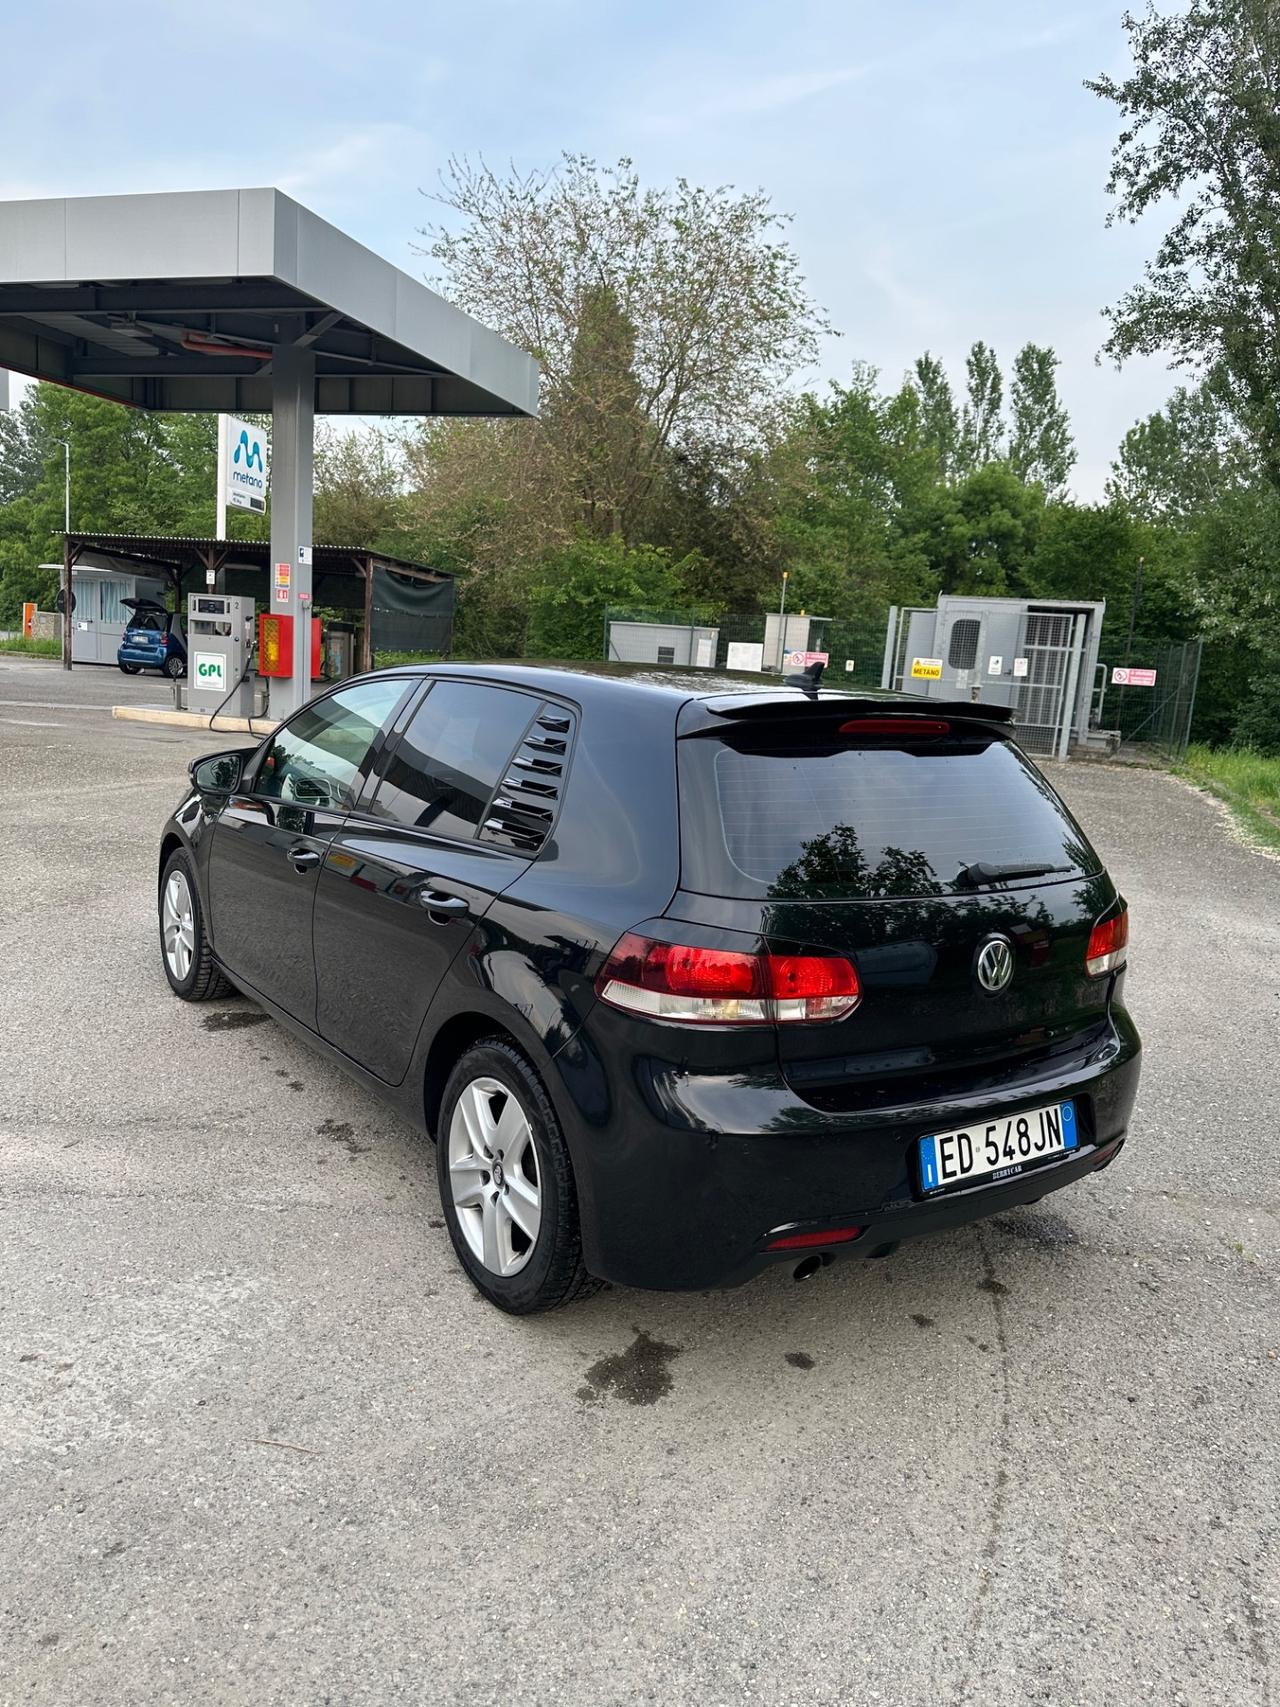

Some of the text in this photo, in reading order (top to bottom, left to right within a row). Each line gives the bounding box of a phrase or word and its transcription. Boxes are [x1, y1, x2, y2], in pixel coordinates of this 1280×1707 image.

[233, 472, 262, 489] metano
[198, 662, 223, 677] GPL
[913, 668, 939, 676] METANO
[940, 1108, 1061, 1180] ED 548JN
